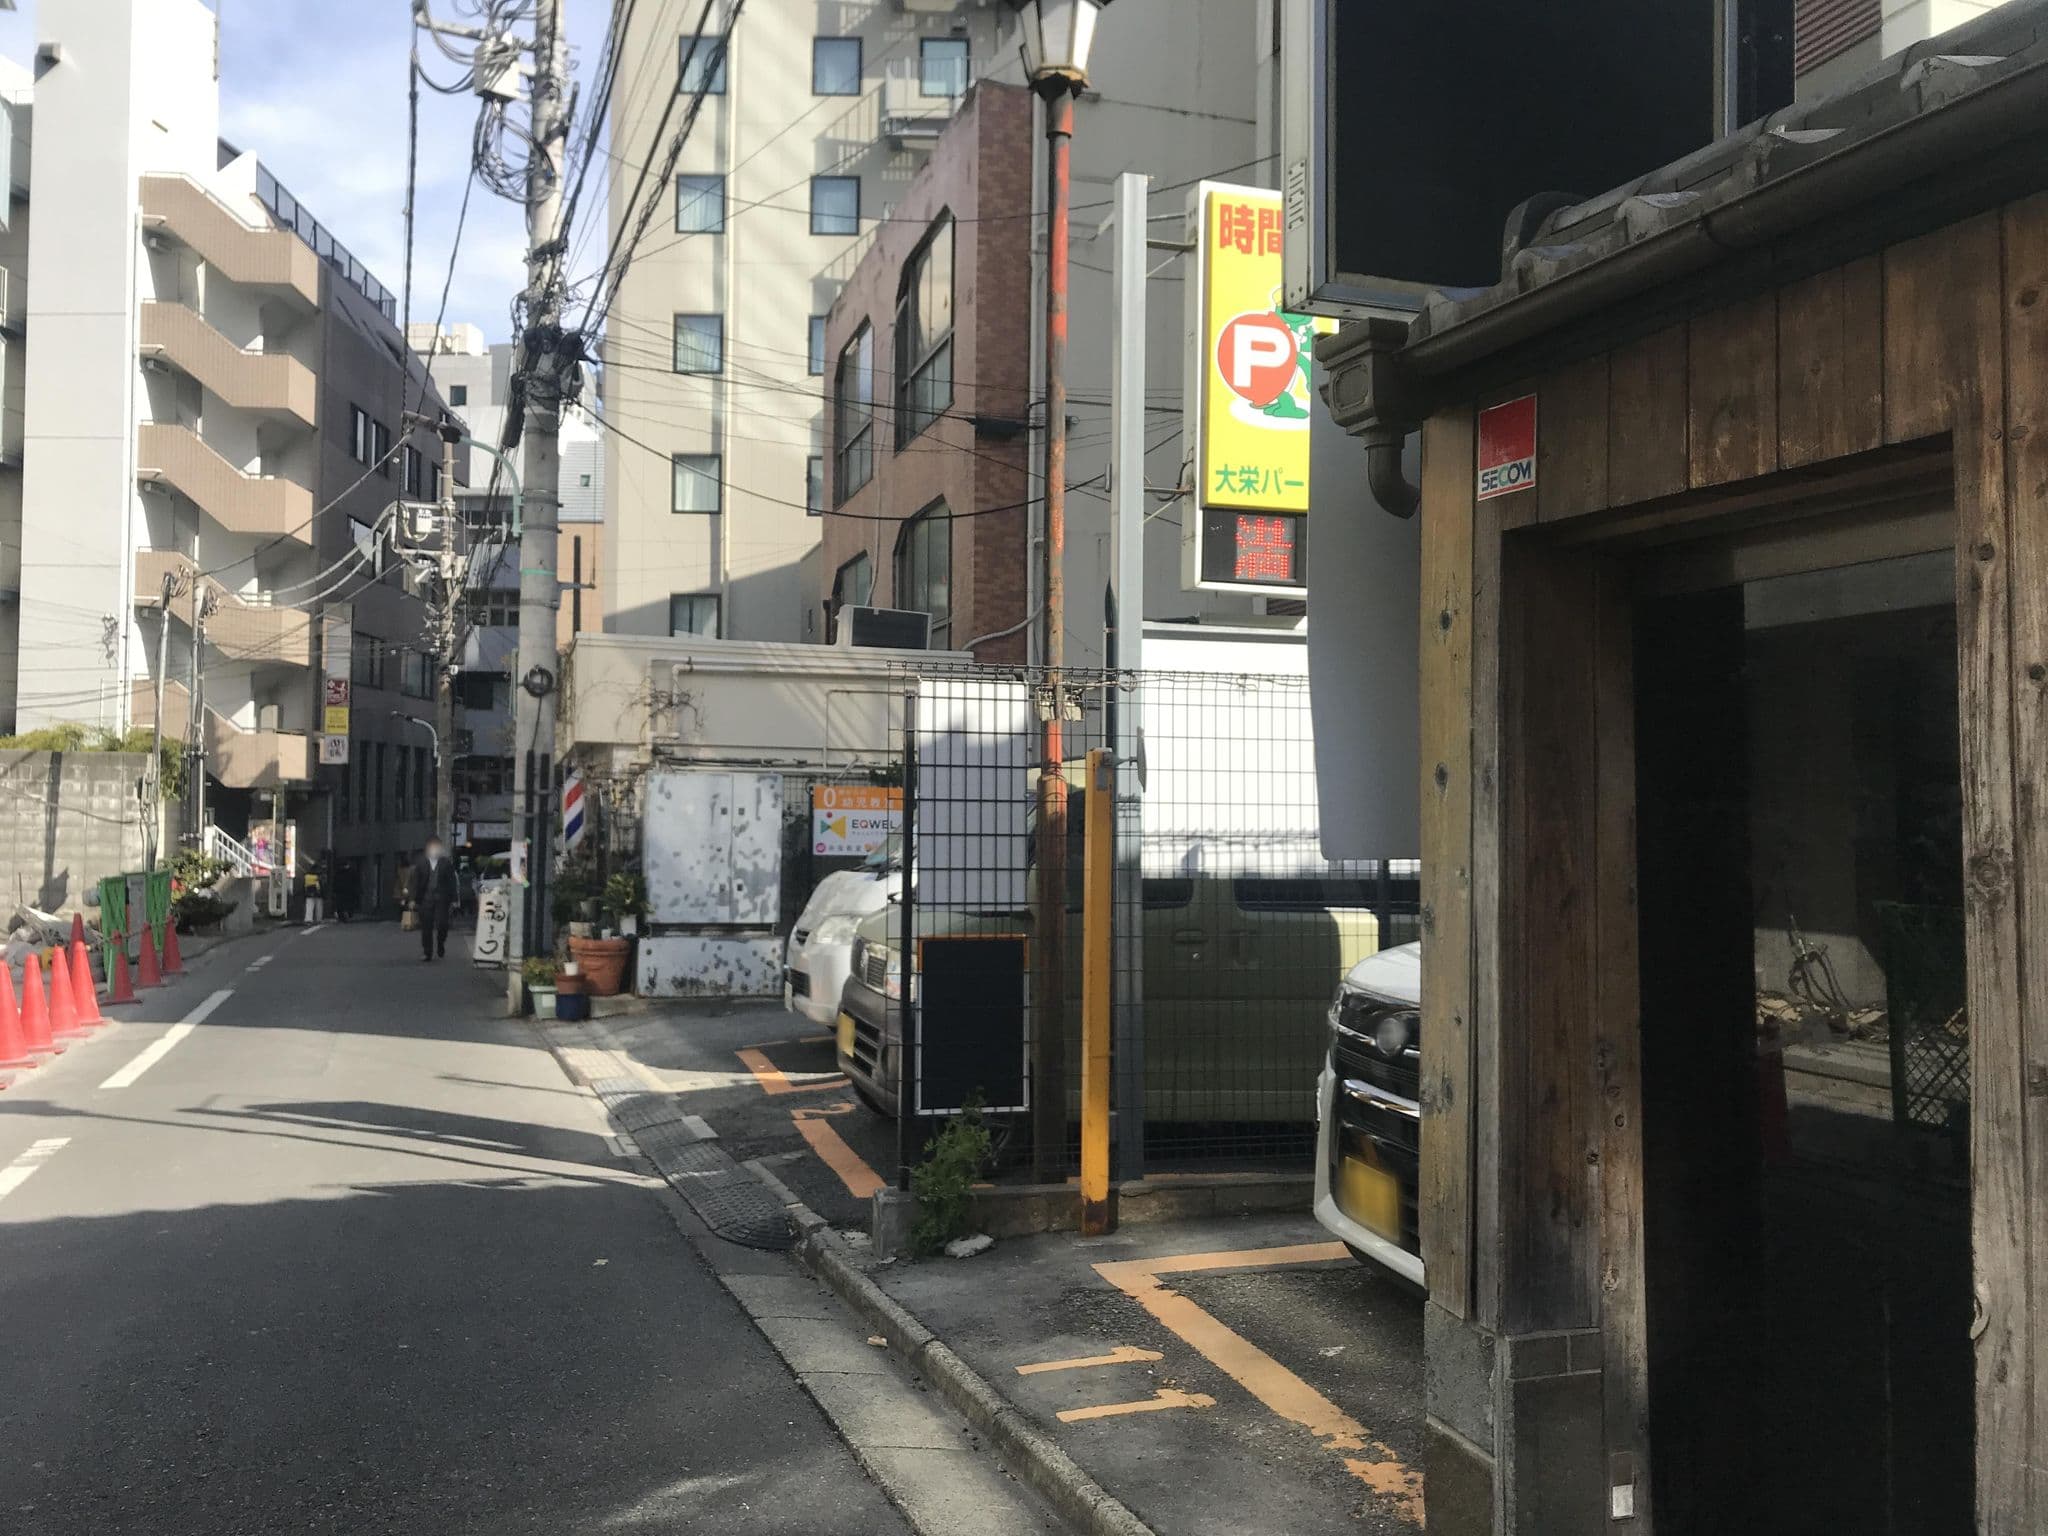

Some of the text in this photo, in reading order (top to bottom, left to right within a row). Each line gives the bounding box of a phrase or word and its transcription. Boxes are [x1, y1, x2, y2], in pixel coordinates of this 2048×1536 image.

[1233, 324, 1290, 388] P
[1215, 465, 1305, 496] 大栄パー
[1481, 460, 1532, 492] SECOM
[1233, 515, 1294, 580] 満
[851, 819, 897, 830] EQWEL
